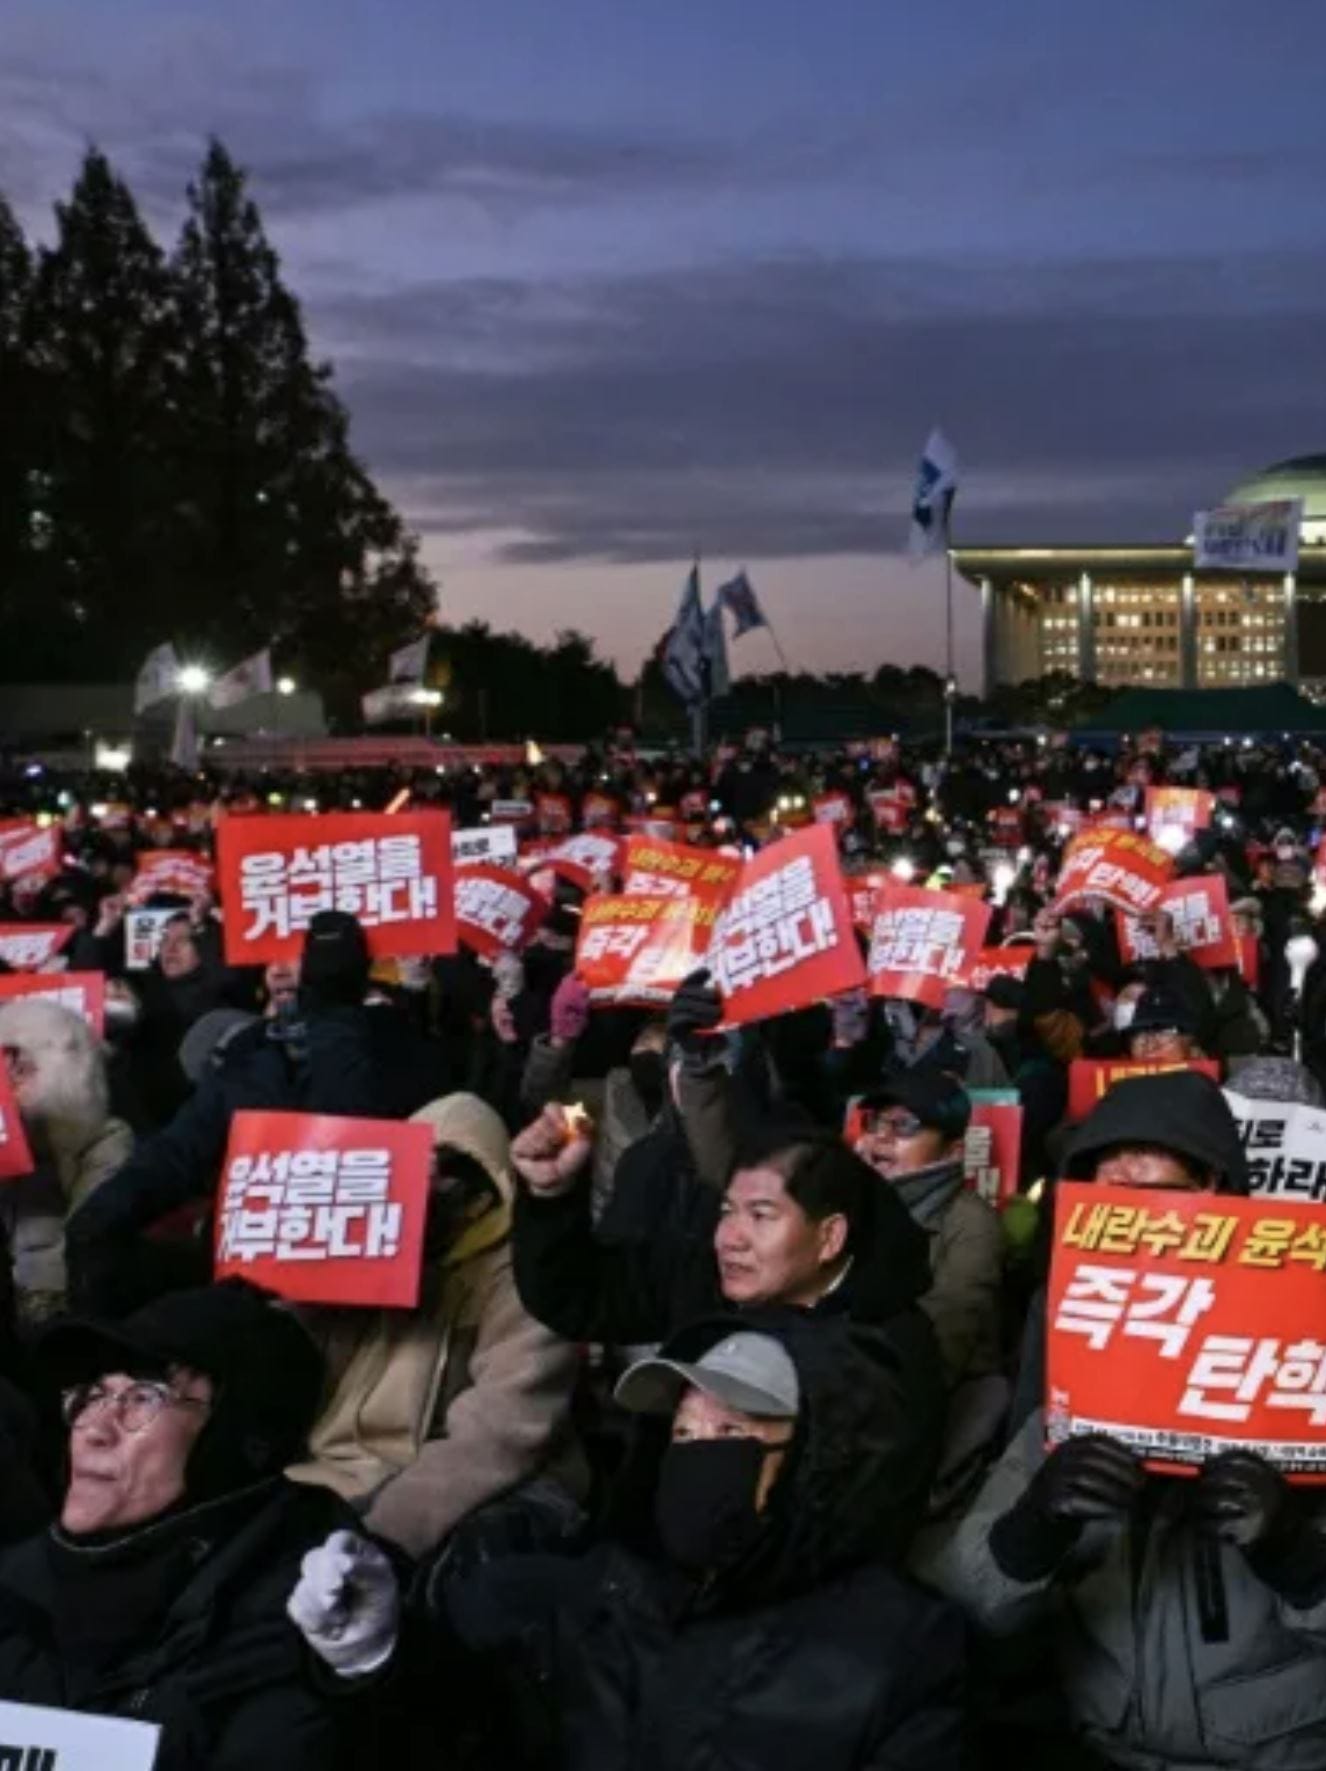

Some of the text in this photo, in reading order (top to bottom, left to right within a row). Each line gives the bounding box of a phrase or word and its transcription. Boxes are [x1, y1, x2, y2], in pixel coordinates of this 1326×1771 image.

[241, 834, 421, 900] 윤석열을
[1062, 1202, 1240, 1262] 내란수괴
[1055, 1264, 1216, 1358] 즉각
